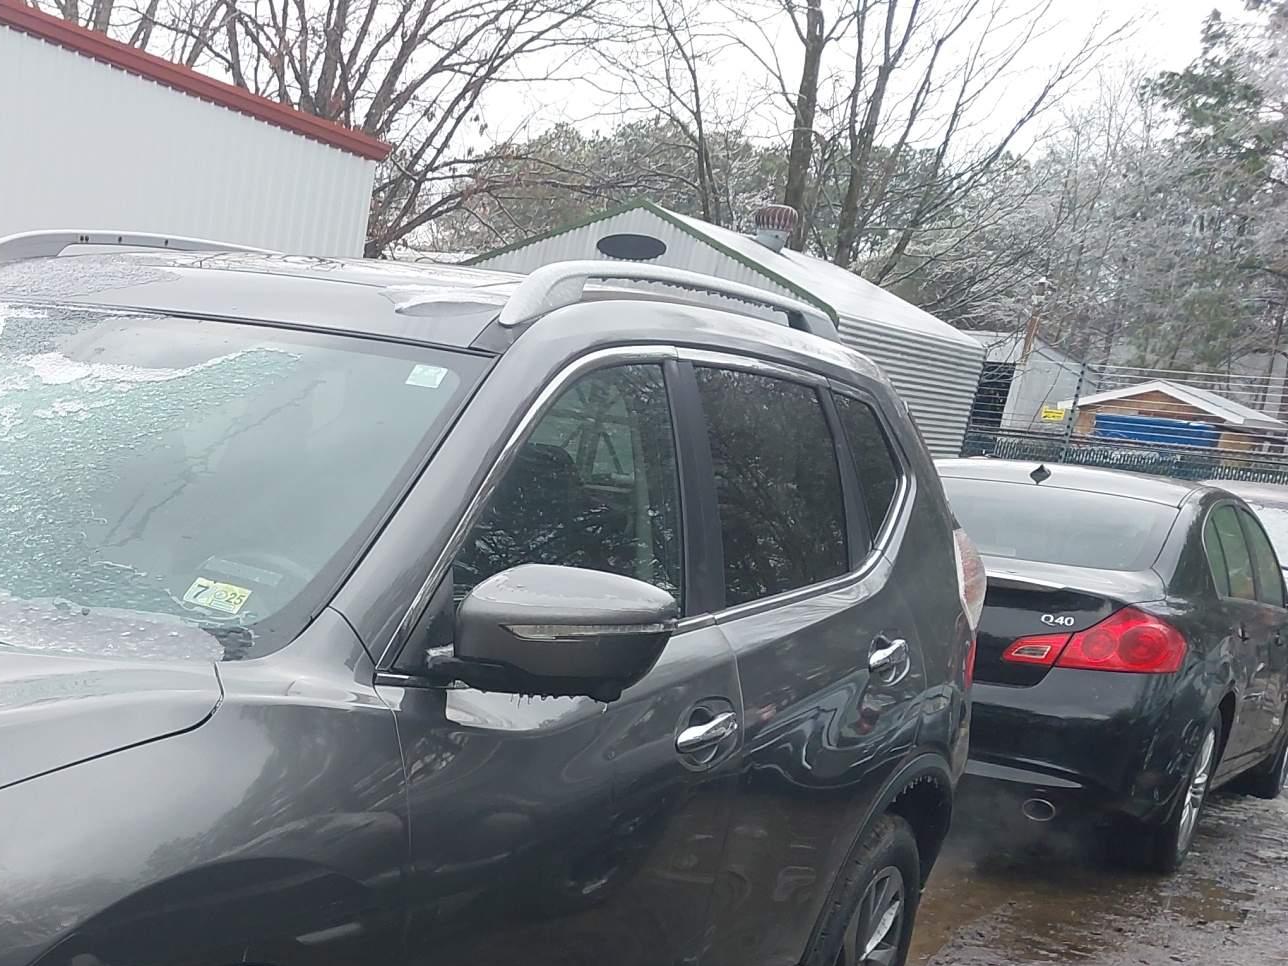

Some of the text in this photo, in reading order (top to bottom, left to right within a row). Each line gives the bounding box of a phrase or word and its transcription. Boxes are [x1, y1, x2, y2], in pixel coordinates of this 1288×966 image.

[193, 584, 209, 599] 7
[225, 592, 246, 605] 25
[1041, 614, 1075, 627] Q40
